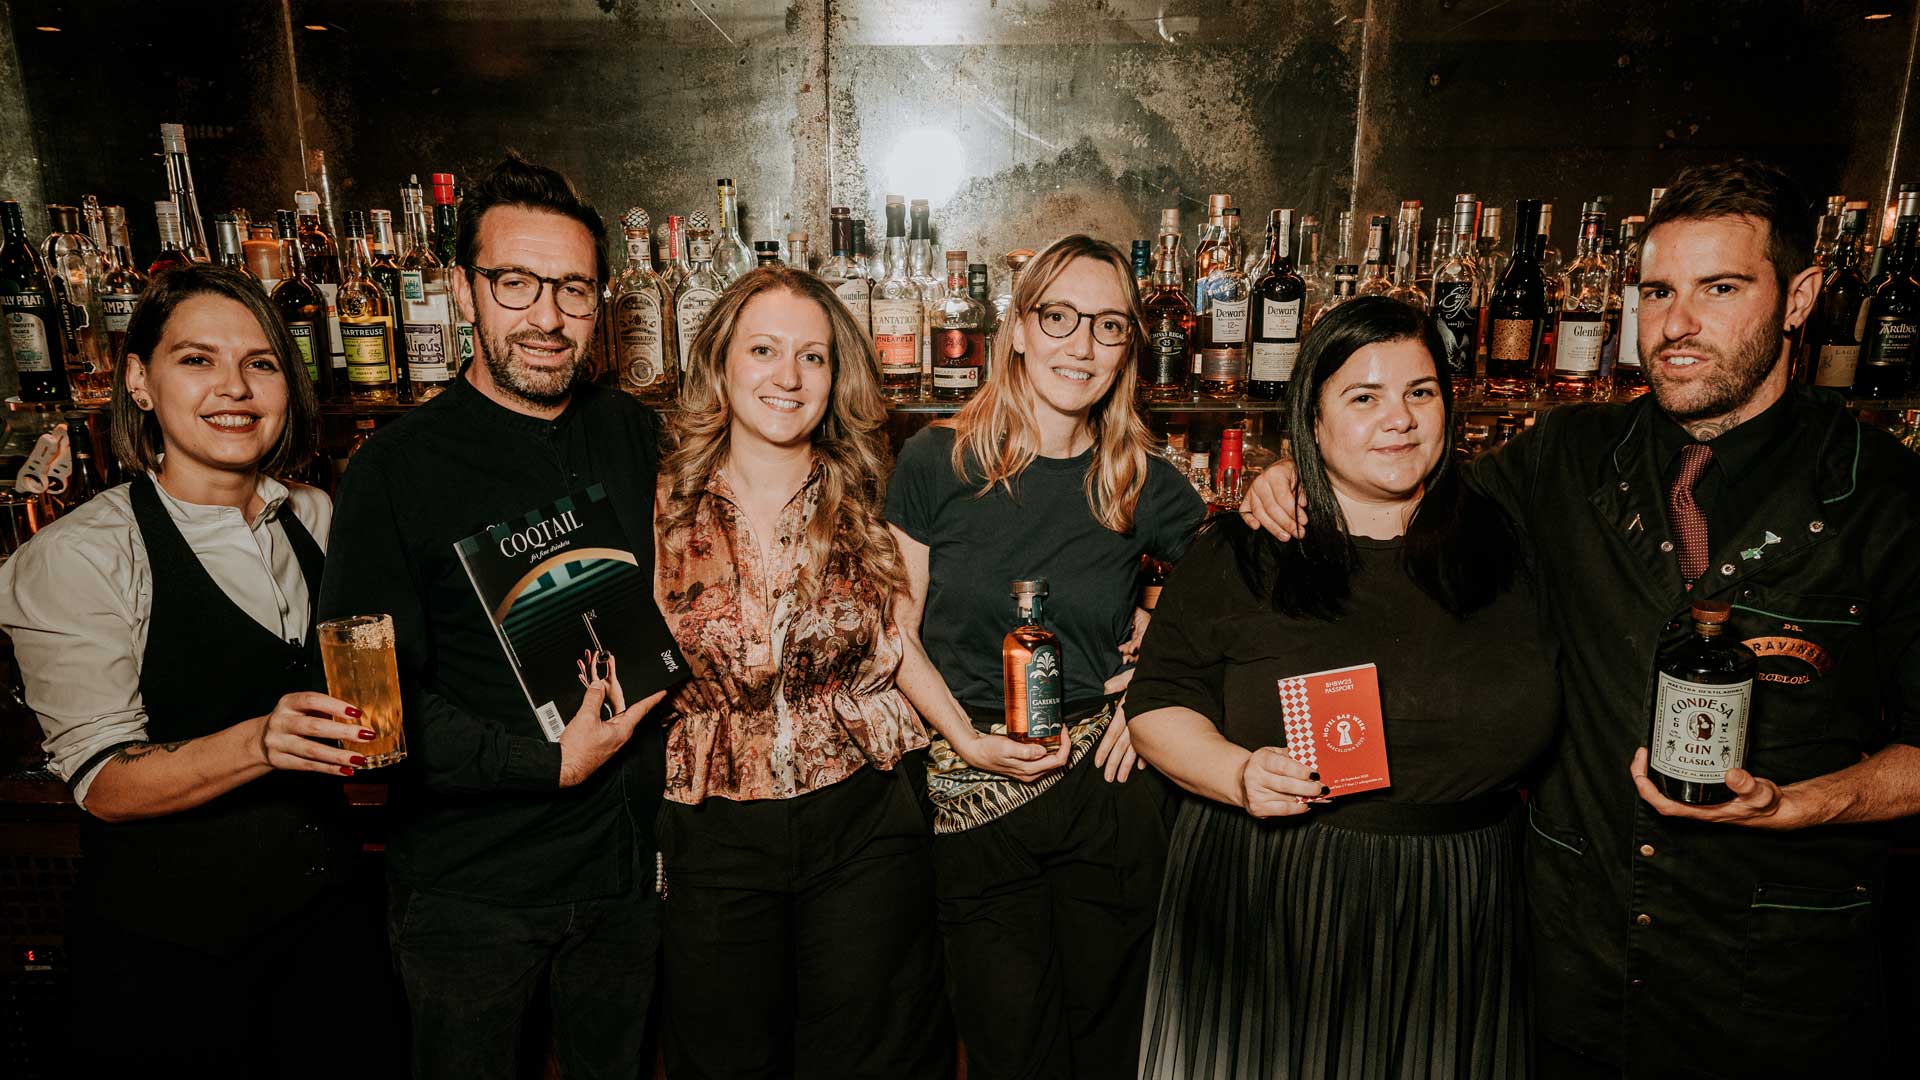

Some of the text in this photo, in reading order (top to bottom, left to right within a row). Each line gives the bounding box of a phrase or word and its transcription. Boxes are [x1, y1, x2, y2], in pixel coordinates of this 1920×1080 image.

[103, 301, 138, 314] AMPA
[876, 335, 914, 344] PINEAPPLE
[968, 370, 976, 380] 8
[500, 510, 584, 558] COQTAIL
[1671, 697, 1735, 719] CONDESA
[1322, 713, 1367, 738] HOTEL BAR WEEK
[1684, 743, 1712, 755] GIN
